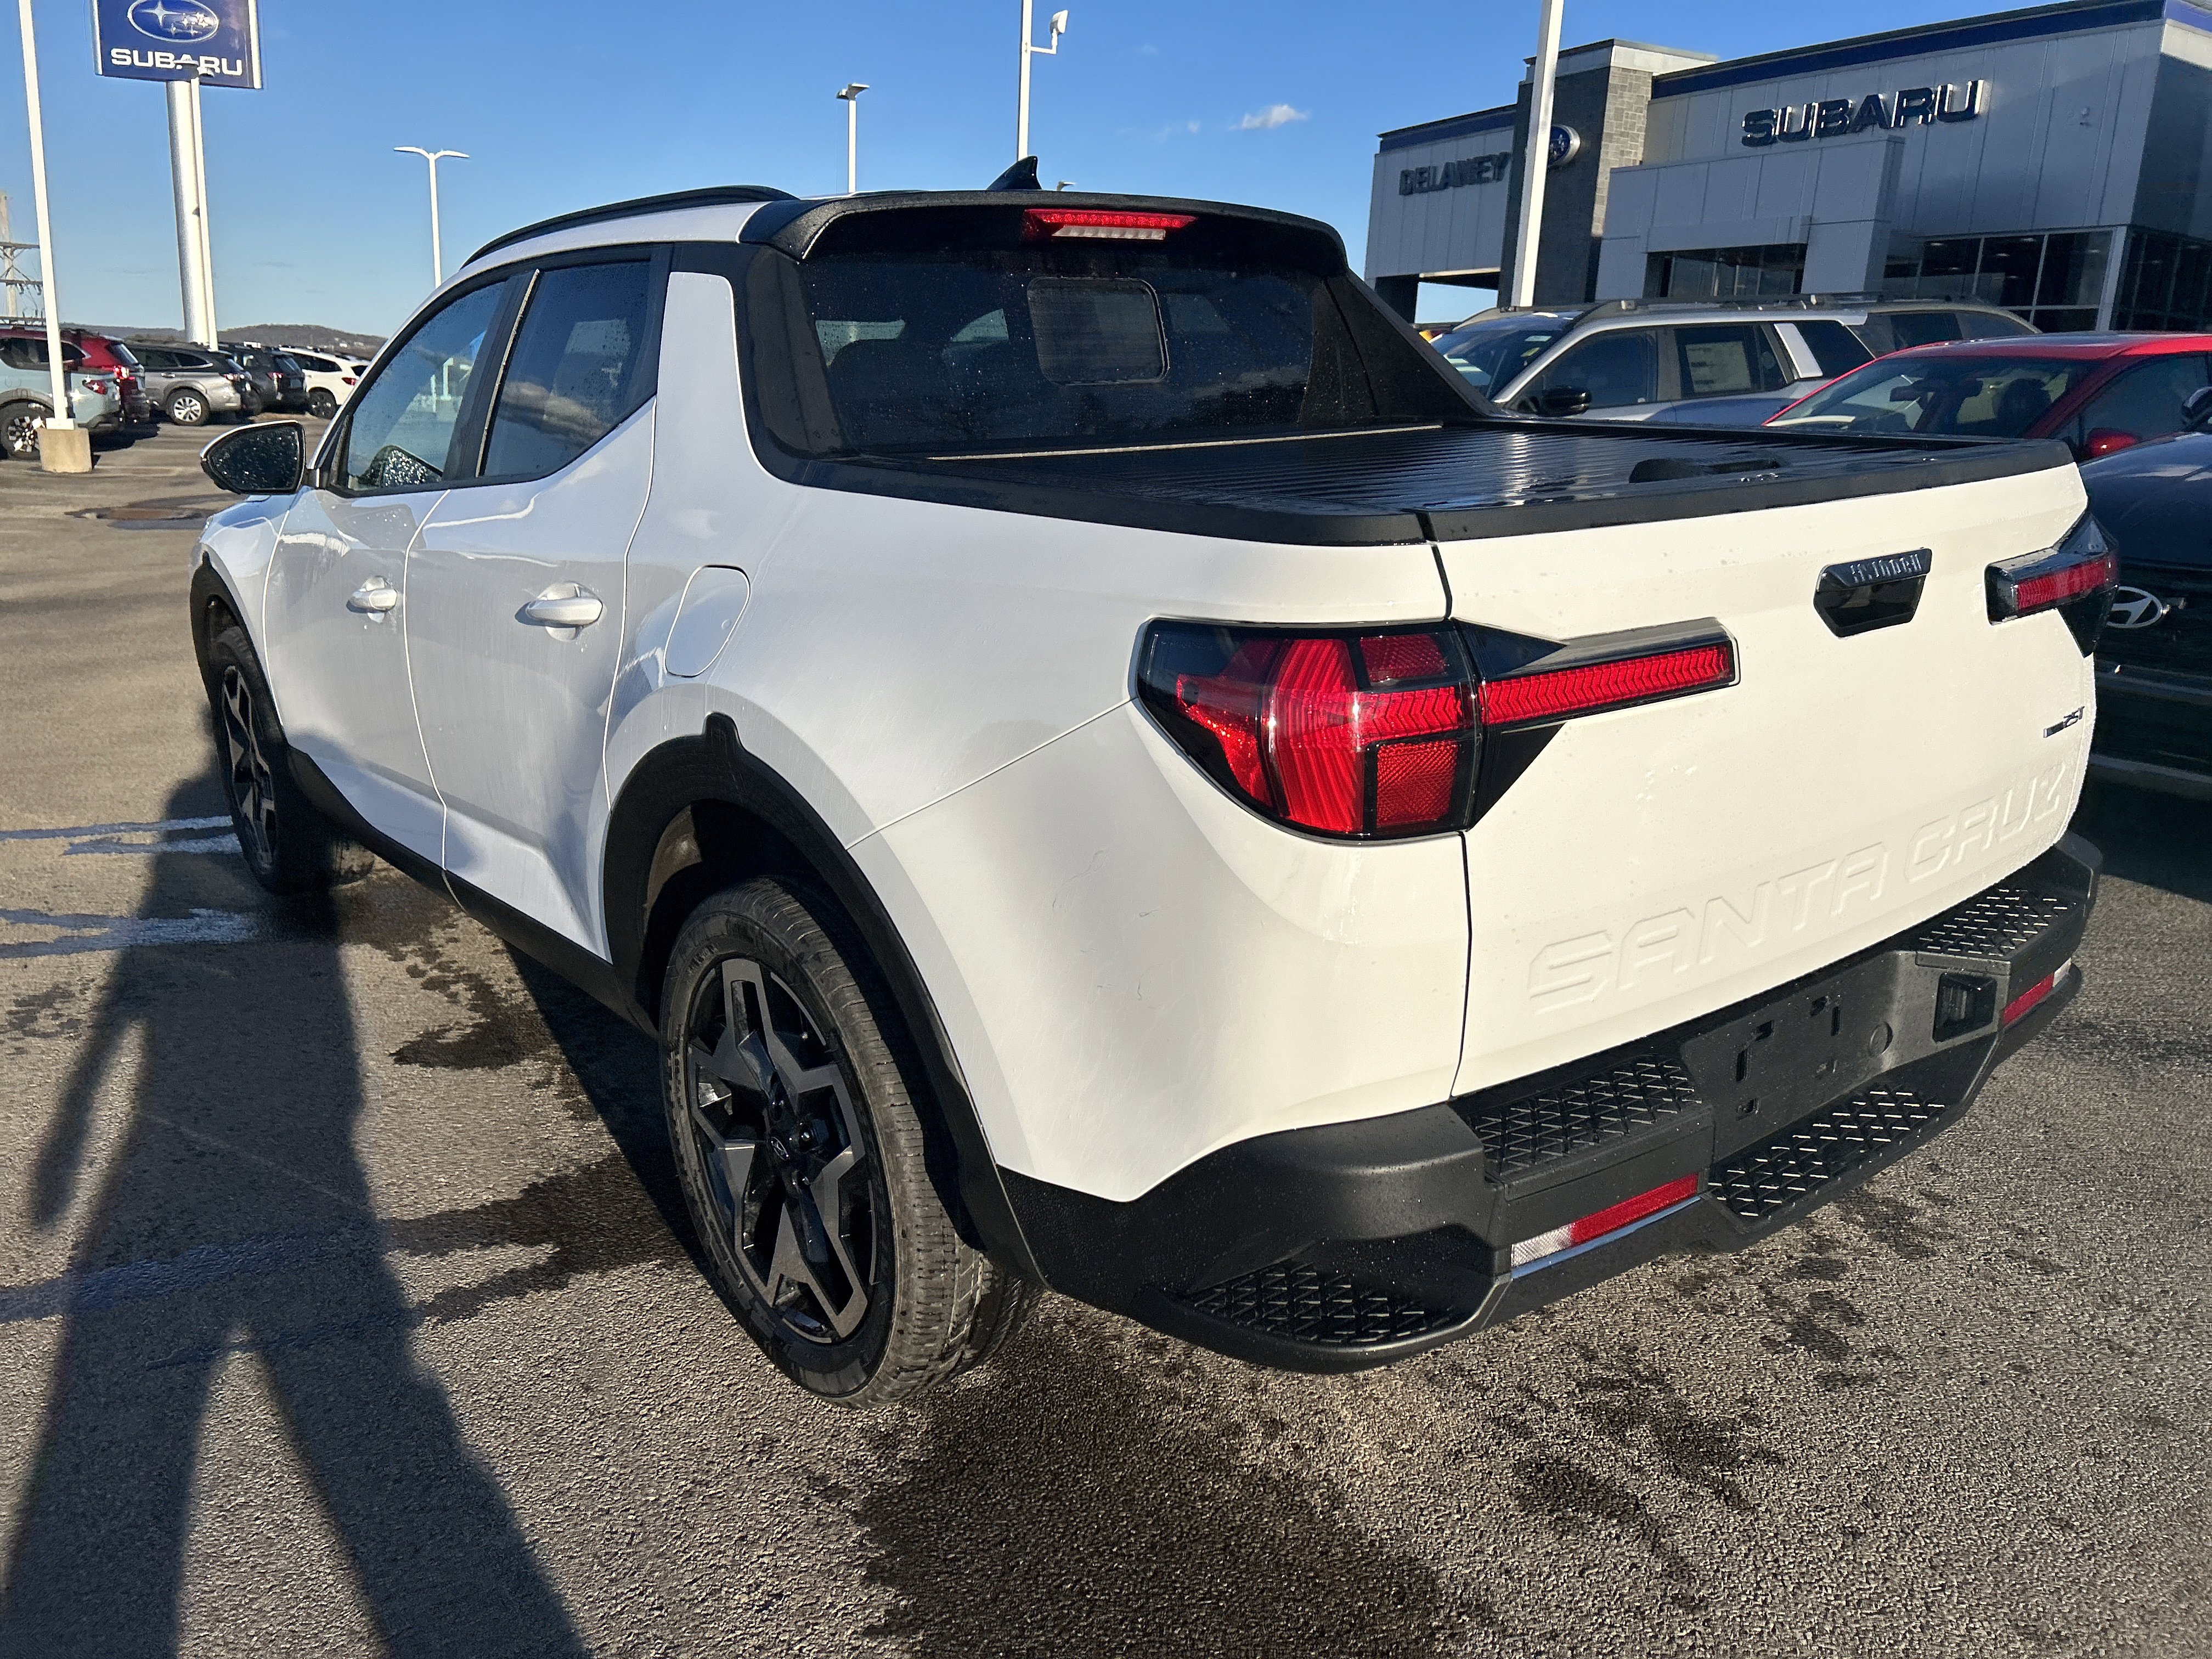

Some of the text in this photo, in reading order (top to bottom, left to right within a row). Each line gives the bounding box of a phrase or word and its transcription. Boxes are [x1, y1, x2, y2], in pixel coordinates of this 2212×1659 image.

[110, 48, 242, 76] SUBARU
[1741, 80, 1984, 147] SUBARU
[1400, 151, 1511, 195] DELANEY
[1527, 763, 2066, 1015] SANTA CRUZ
